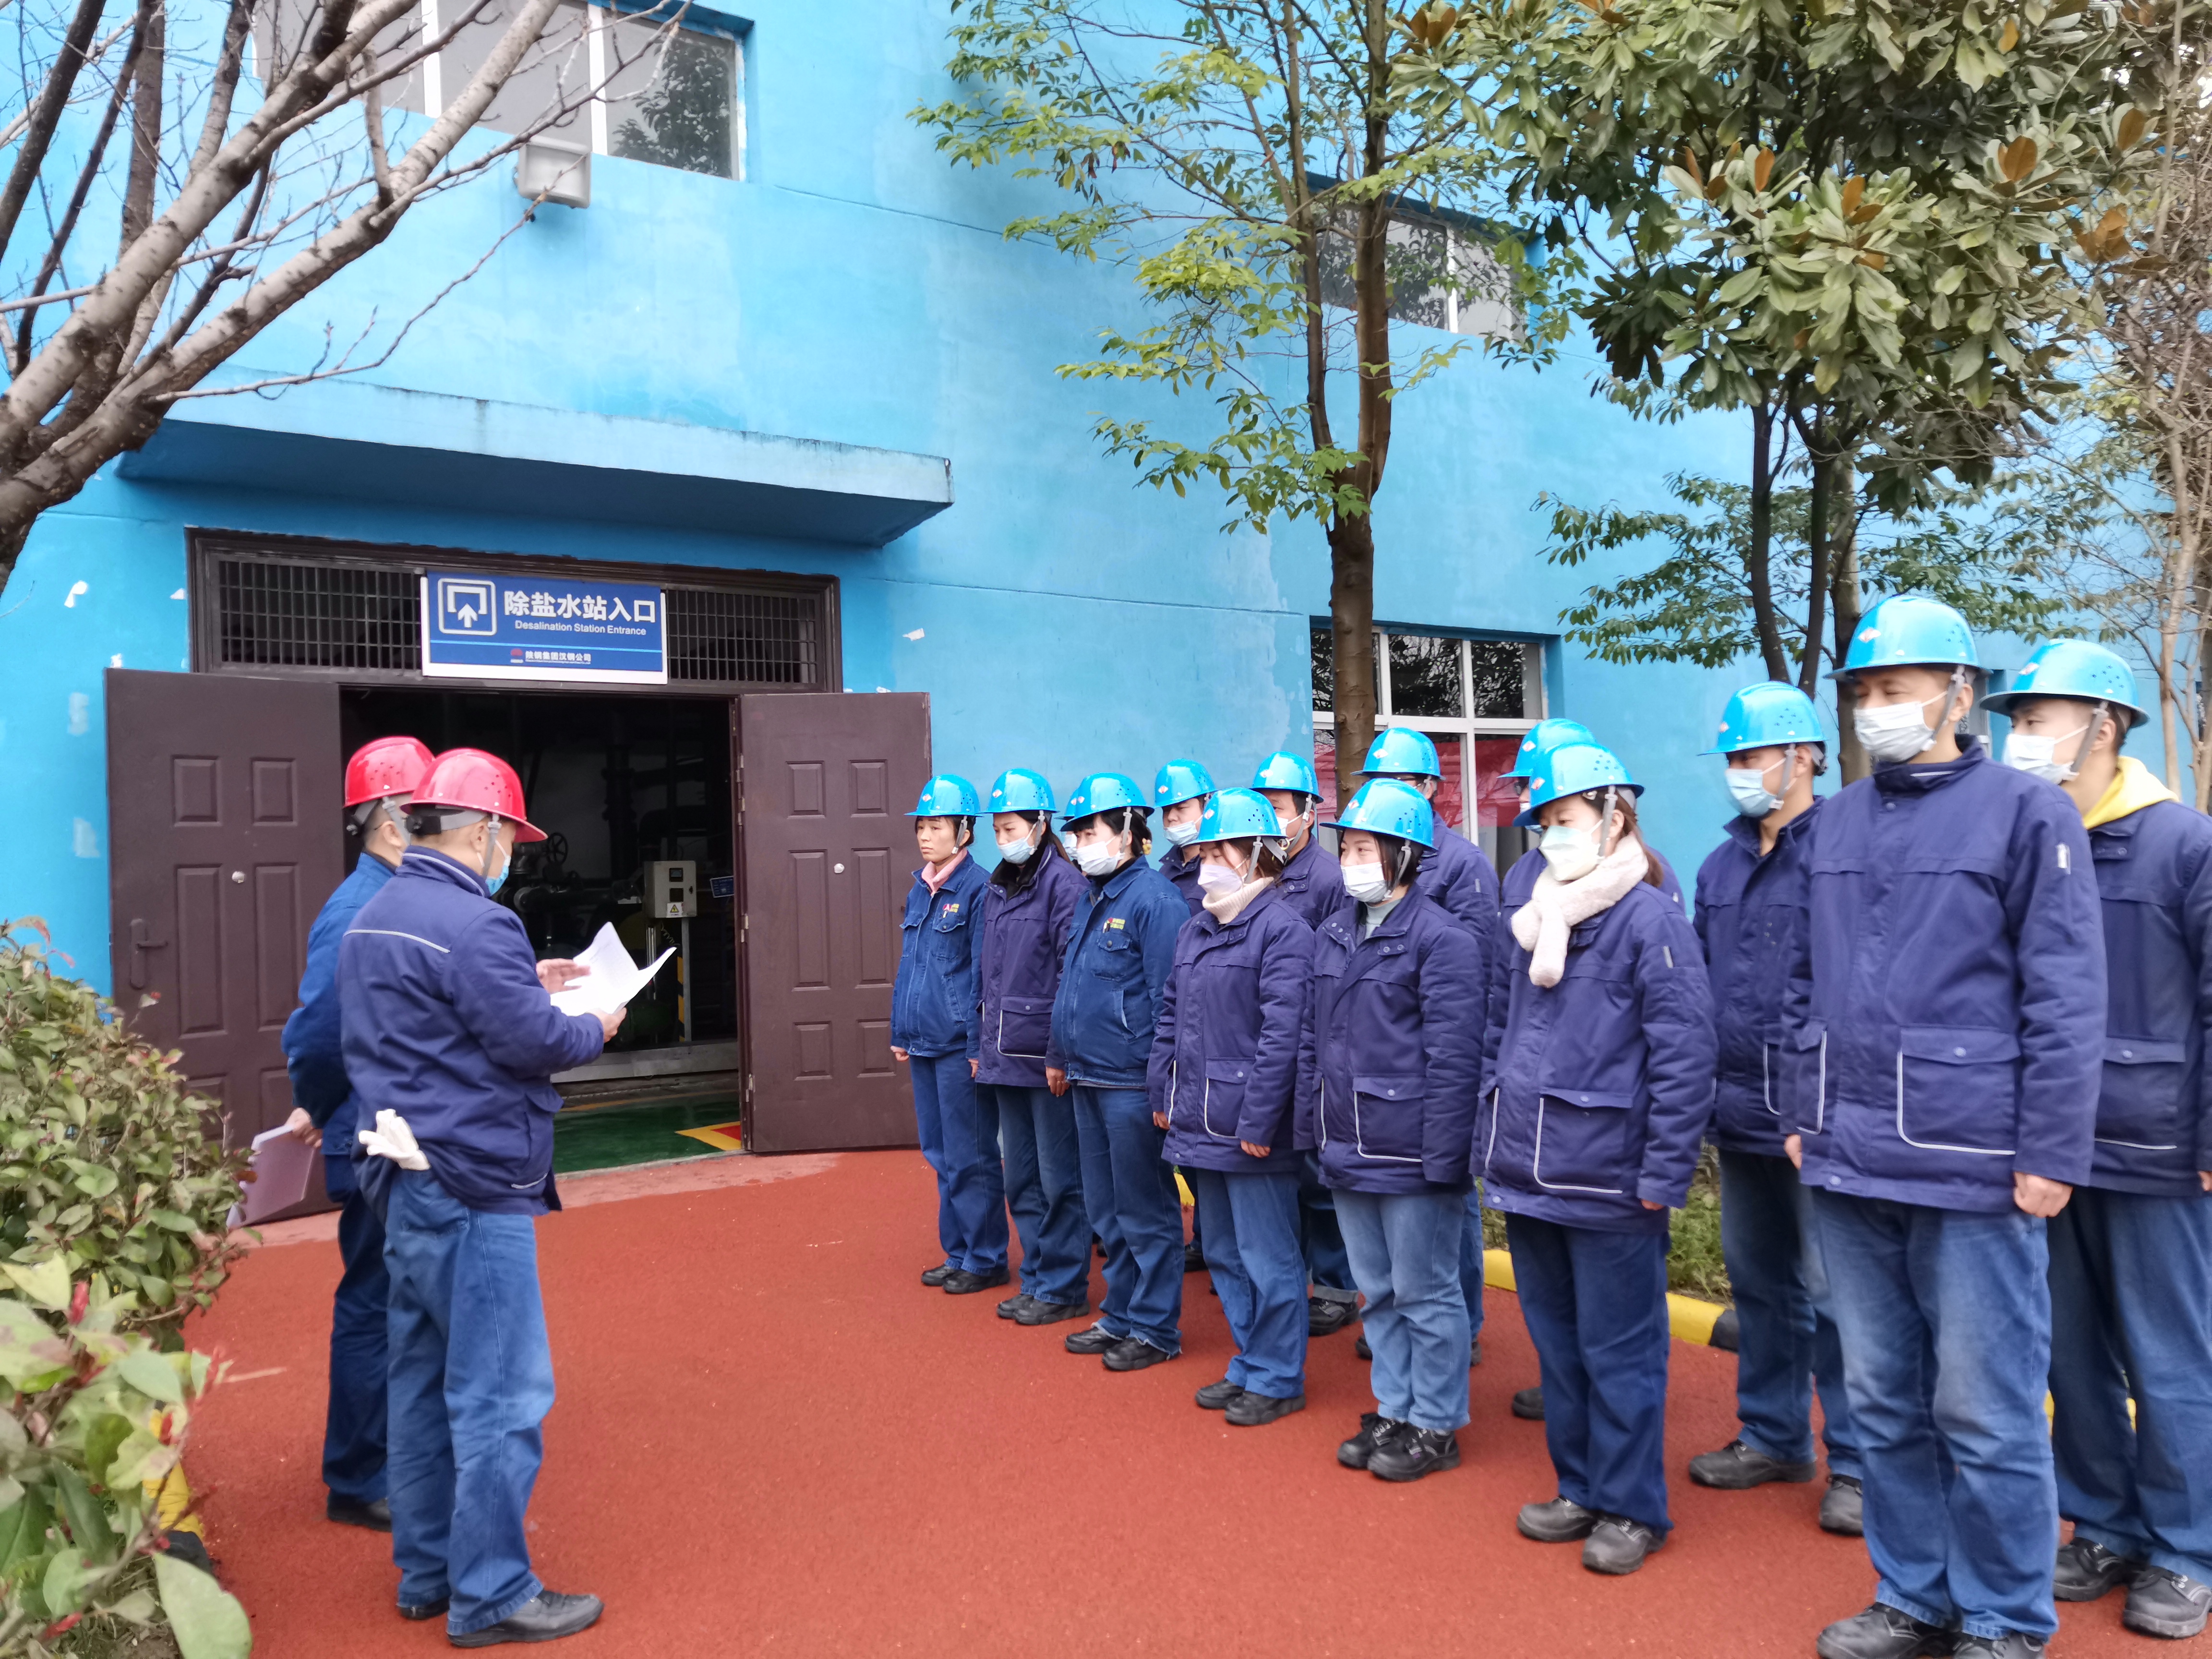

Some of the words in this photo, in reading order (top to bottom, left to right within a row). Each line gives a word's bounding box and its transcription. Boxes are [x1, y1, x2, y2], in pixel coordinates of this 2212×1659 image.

[504, 590, 656, 623] 除盐水站入口
[515, 620, 572, 631] Desalination
[574, 624, 606, 633] Station
[607, 626, 647, 636] Entrance
